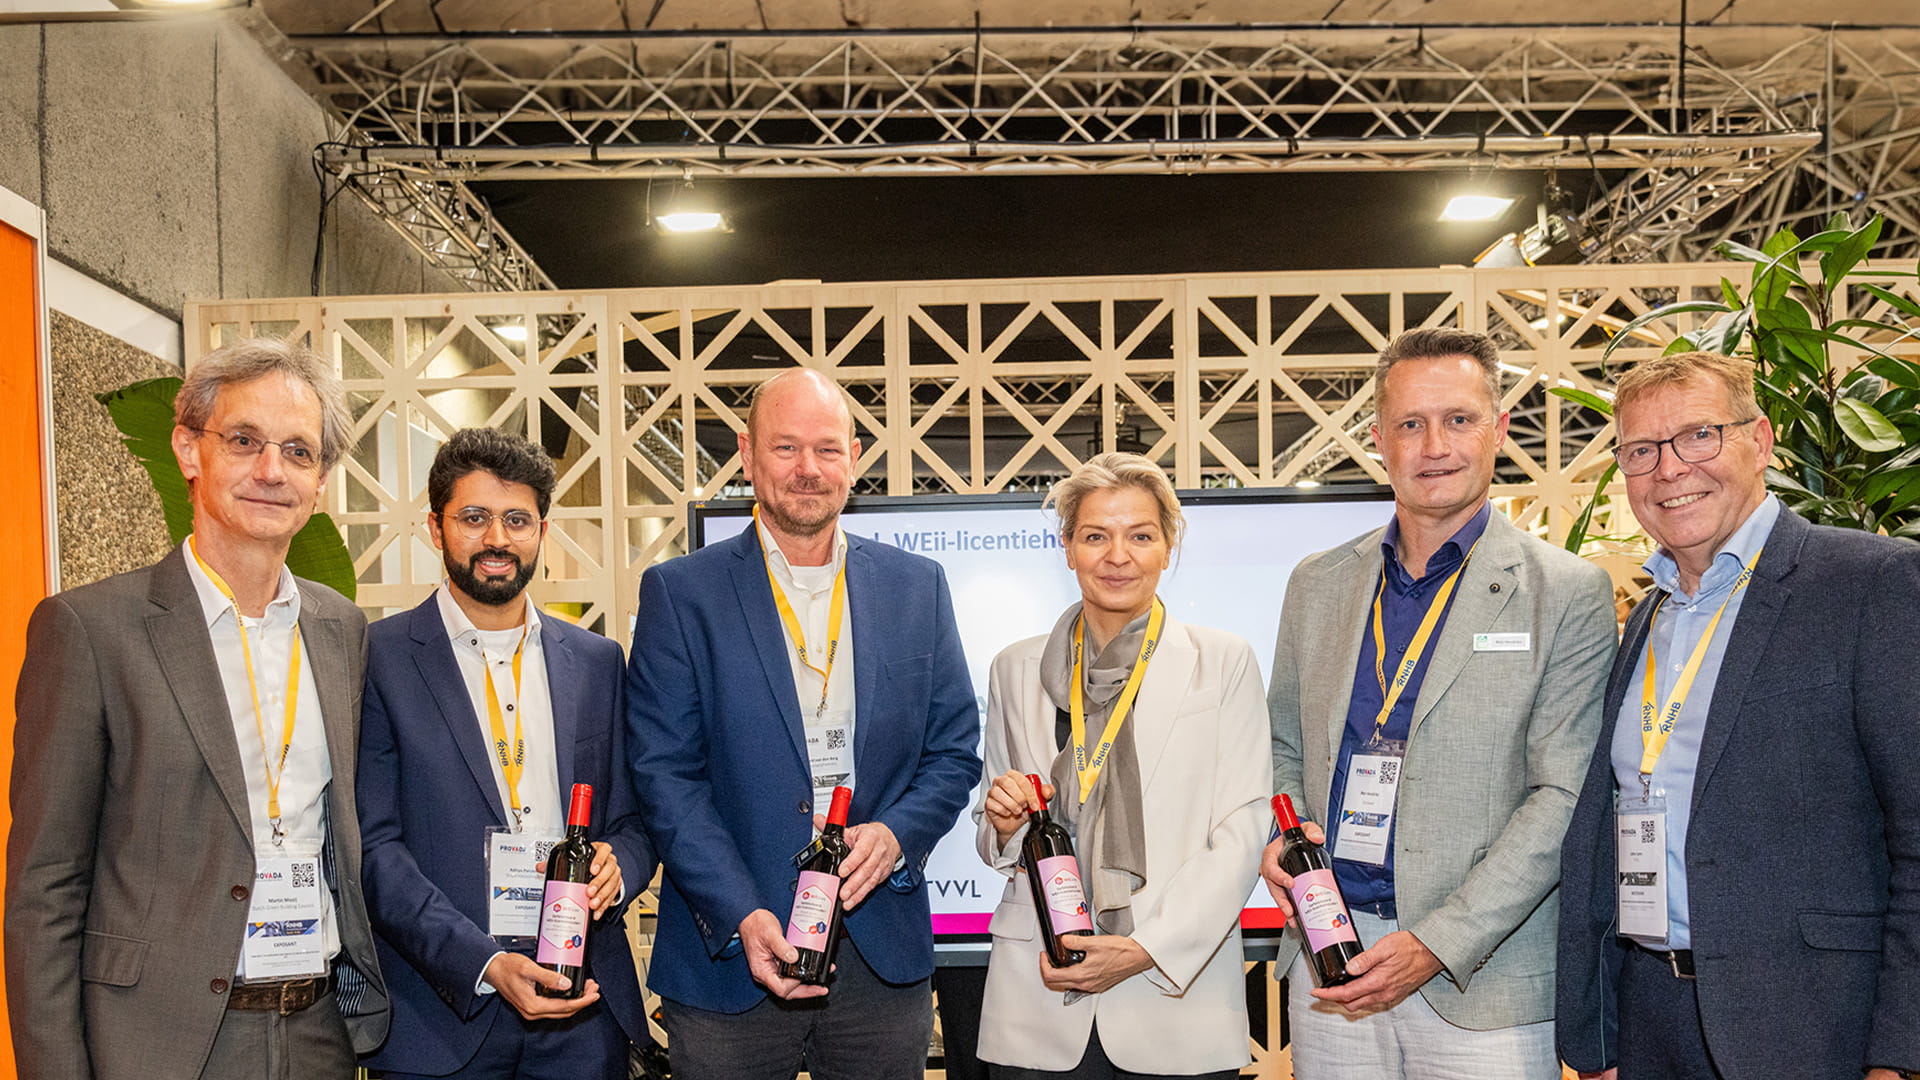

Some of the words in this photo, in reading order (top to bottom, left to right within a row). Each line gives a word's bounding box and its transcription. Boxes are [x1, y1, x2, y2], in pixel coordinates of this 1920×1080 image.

[1142, 640, 1154, 662] RNHB
[1397, 660, 1415, 687] RNHB
[1643, 703, 1654, 732] RNHB
[1660, 702, 1681, 734] RNHB
[497, 740, 509, 767] RNHB
[1075, 745, 1086, 771] RNHB
[1093, 742, 1111, 768] RNHB
